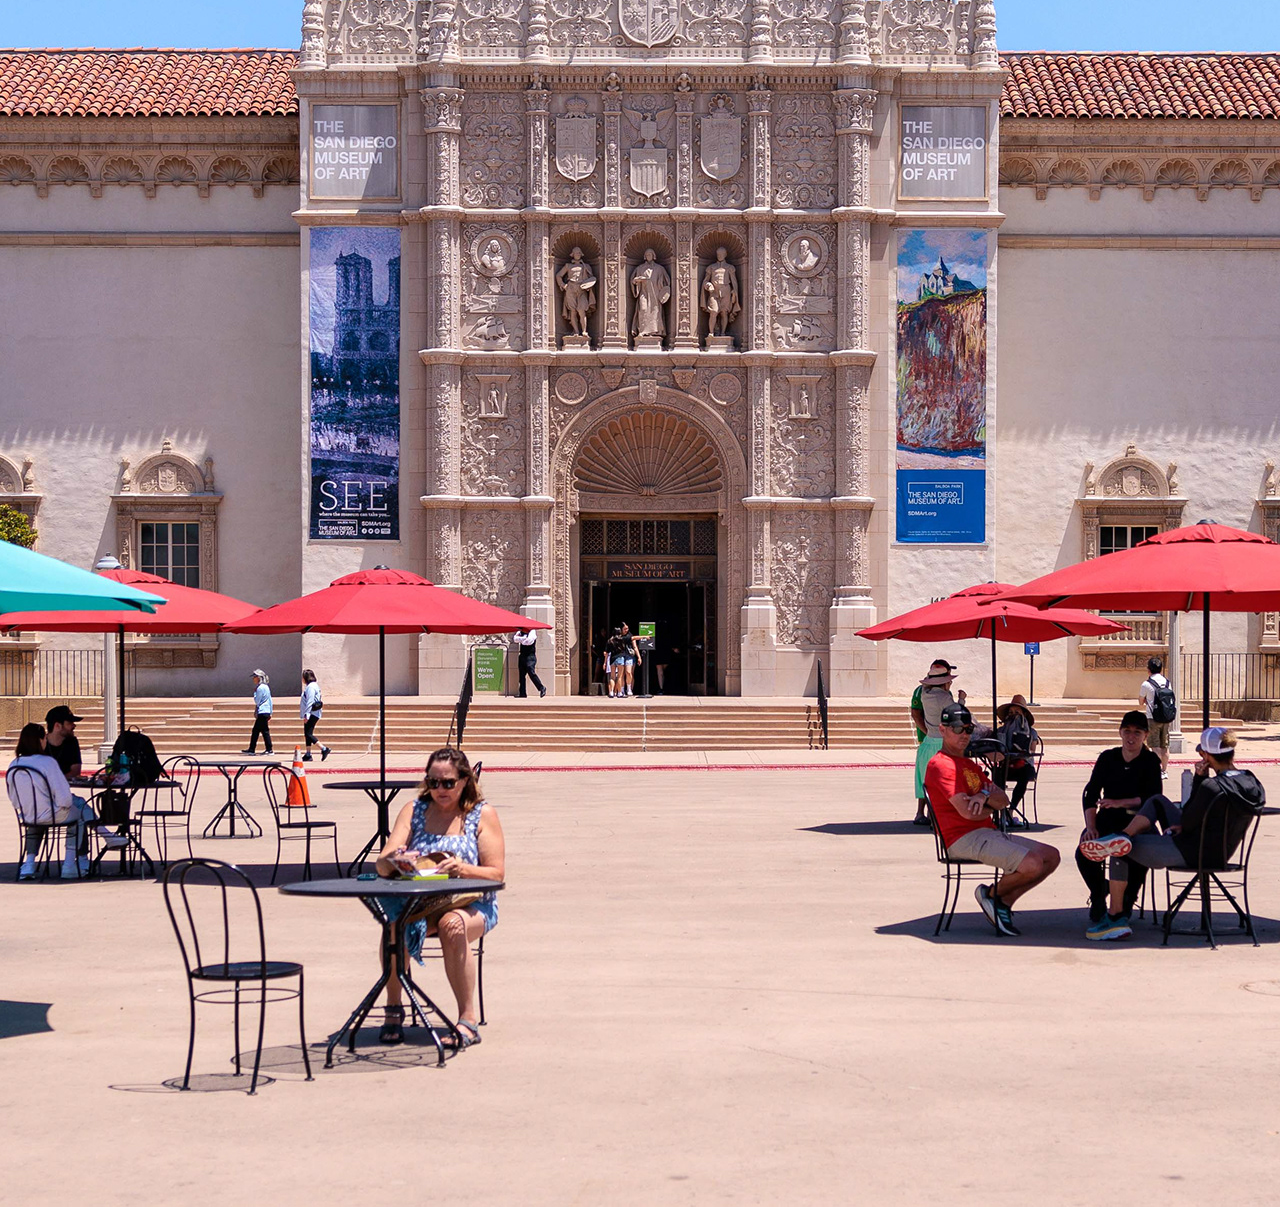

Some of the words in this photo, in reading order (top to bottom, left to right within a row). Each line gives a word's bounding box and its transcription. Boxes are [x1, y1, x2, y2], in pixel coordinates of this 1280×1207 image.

[314, 120, 344, 133] THE
[903, 121, 933, 133] THE
[314, 136, 345, 148] SAN
[349, 136, 397, 148] DIEGO
[902, 136, 934, 149] SAN
[938, 137, 985, 150] DIEGO
[314, 151, 383, 164] MUSEUM
[903, 152, 971, 165] MUSEUM
[314, 167, 335, 180] OF
[338, 167, 369, 180] ART
[902, 168, 924, 180] OF
[926, 168, 957, 181] ART
[319, 480, 388, 511] SEE
